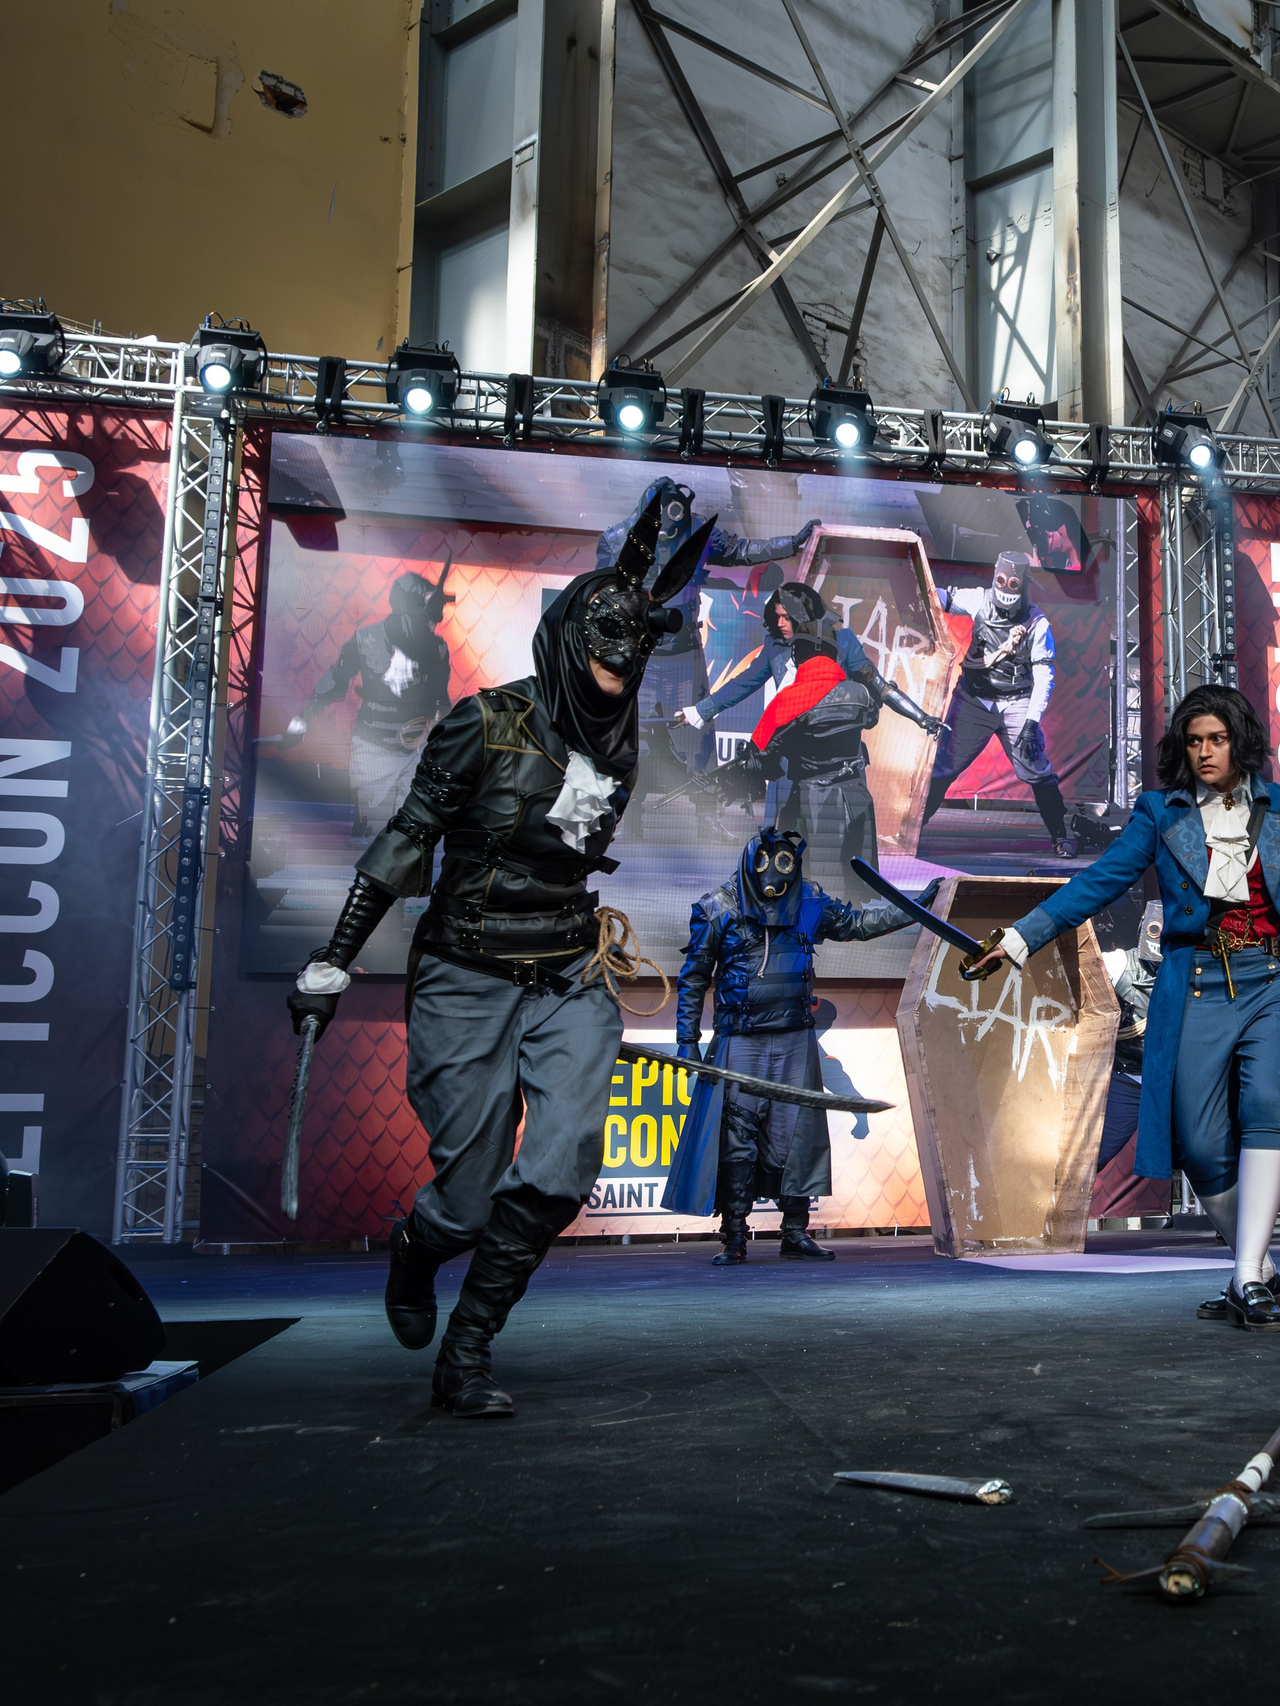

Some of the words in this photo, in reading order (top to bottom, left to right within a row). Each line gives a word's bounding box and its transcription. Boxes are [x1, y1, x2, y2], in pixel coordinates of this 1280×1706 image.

[0, 449, 95, 693] 2025
[602, 1114, 687, 1168] CON
[586, 1182, 659, 1210] SAINT
